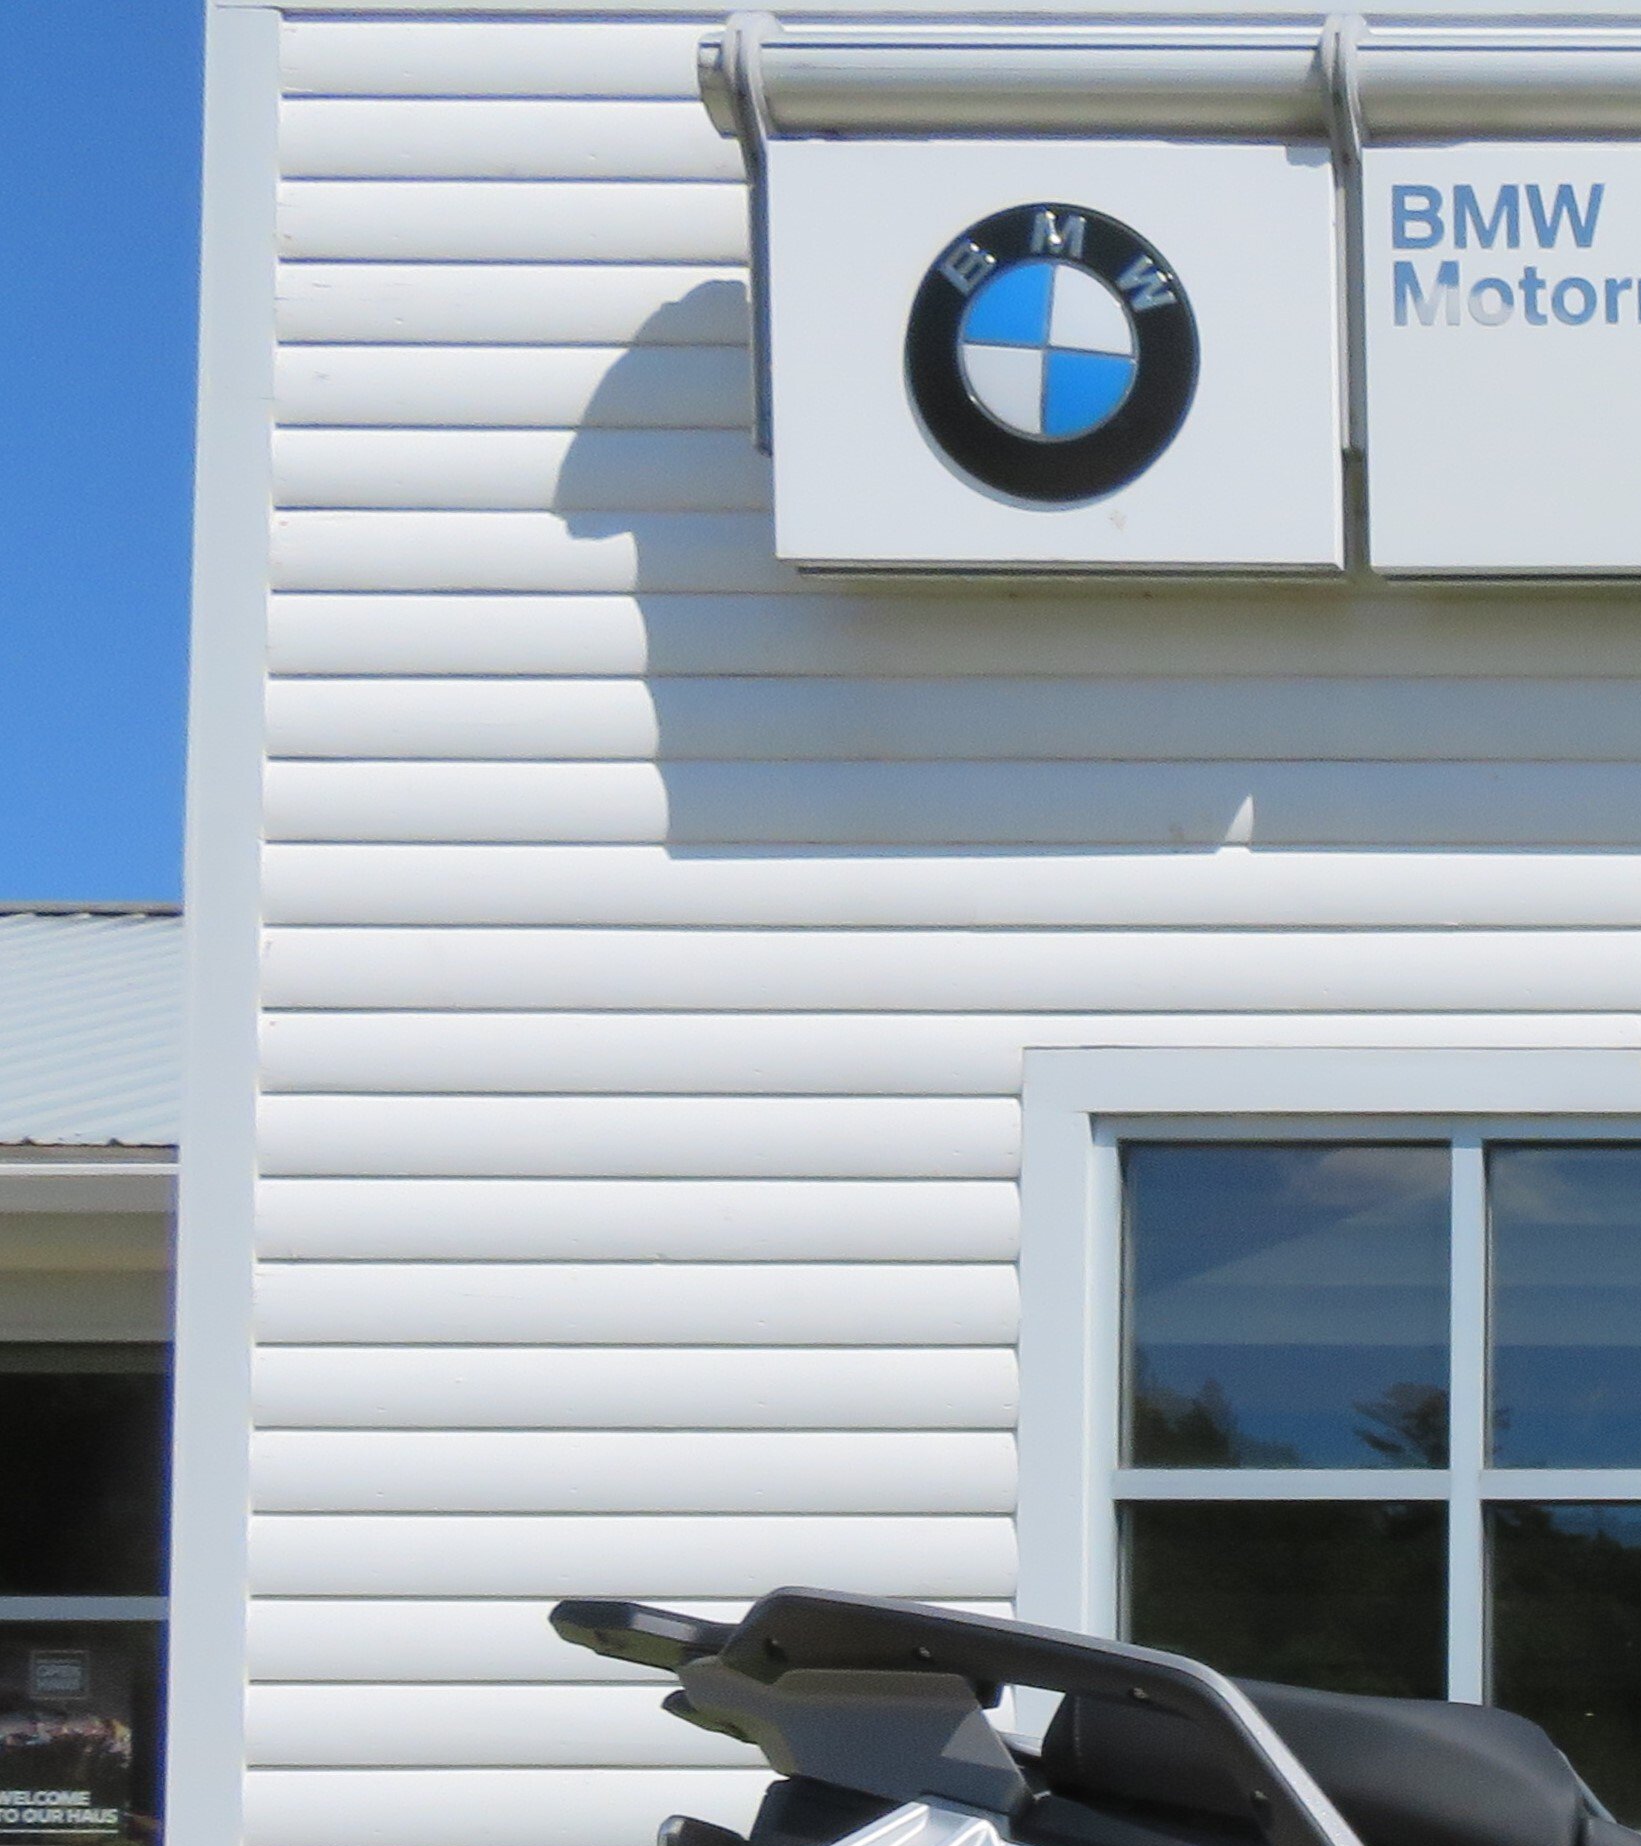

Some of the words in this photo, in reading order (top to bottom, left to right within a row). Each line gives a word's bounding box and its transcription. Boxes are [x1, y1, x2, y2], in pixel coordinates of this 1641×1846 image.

[1391, 182, 1606, 250] BMW
[937, 208, 1177, 313] BMW
[22, 1808, 64, 1823] OUR
[66, 1808, 119, 1824] HAUS
